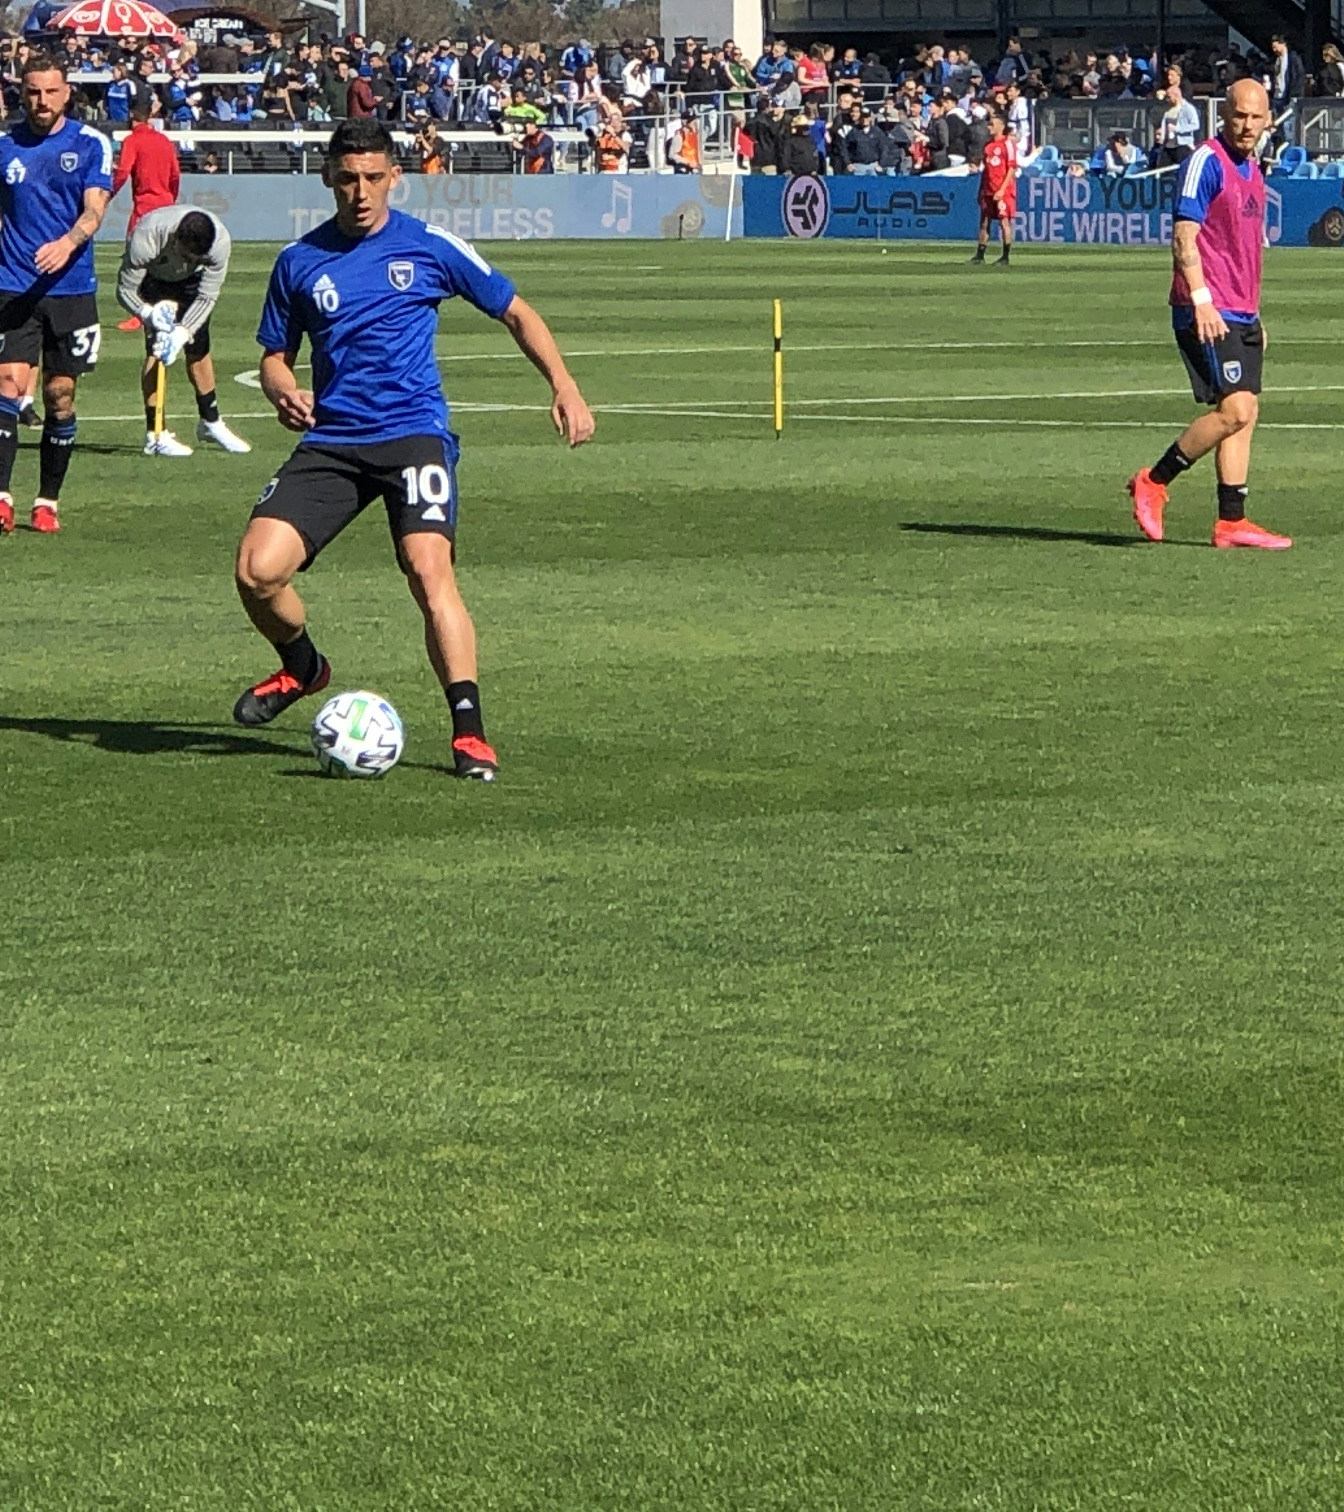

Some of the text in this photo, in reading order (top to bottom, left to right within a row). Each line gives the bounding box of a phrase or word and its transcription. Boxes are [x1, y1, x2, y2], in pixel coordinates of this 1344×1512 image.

[6, 168, 26, 185] 37
[420, 174, 514, 205] YOUR
[1028, 177, 1091, 209] FIND
[857, 218, 927, 229] AUDIO
[998, 211, 1173, 245] RUE WIRELE
[313, 289, 339, 313] 10
[71, 324, 101, 357] 37
[401, 464, 449, 505] 10
